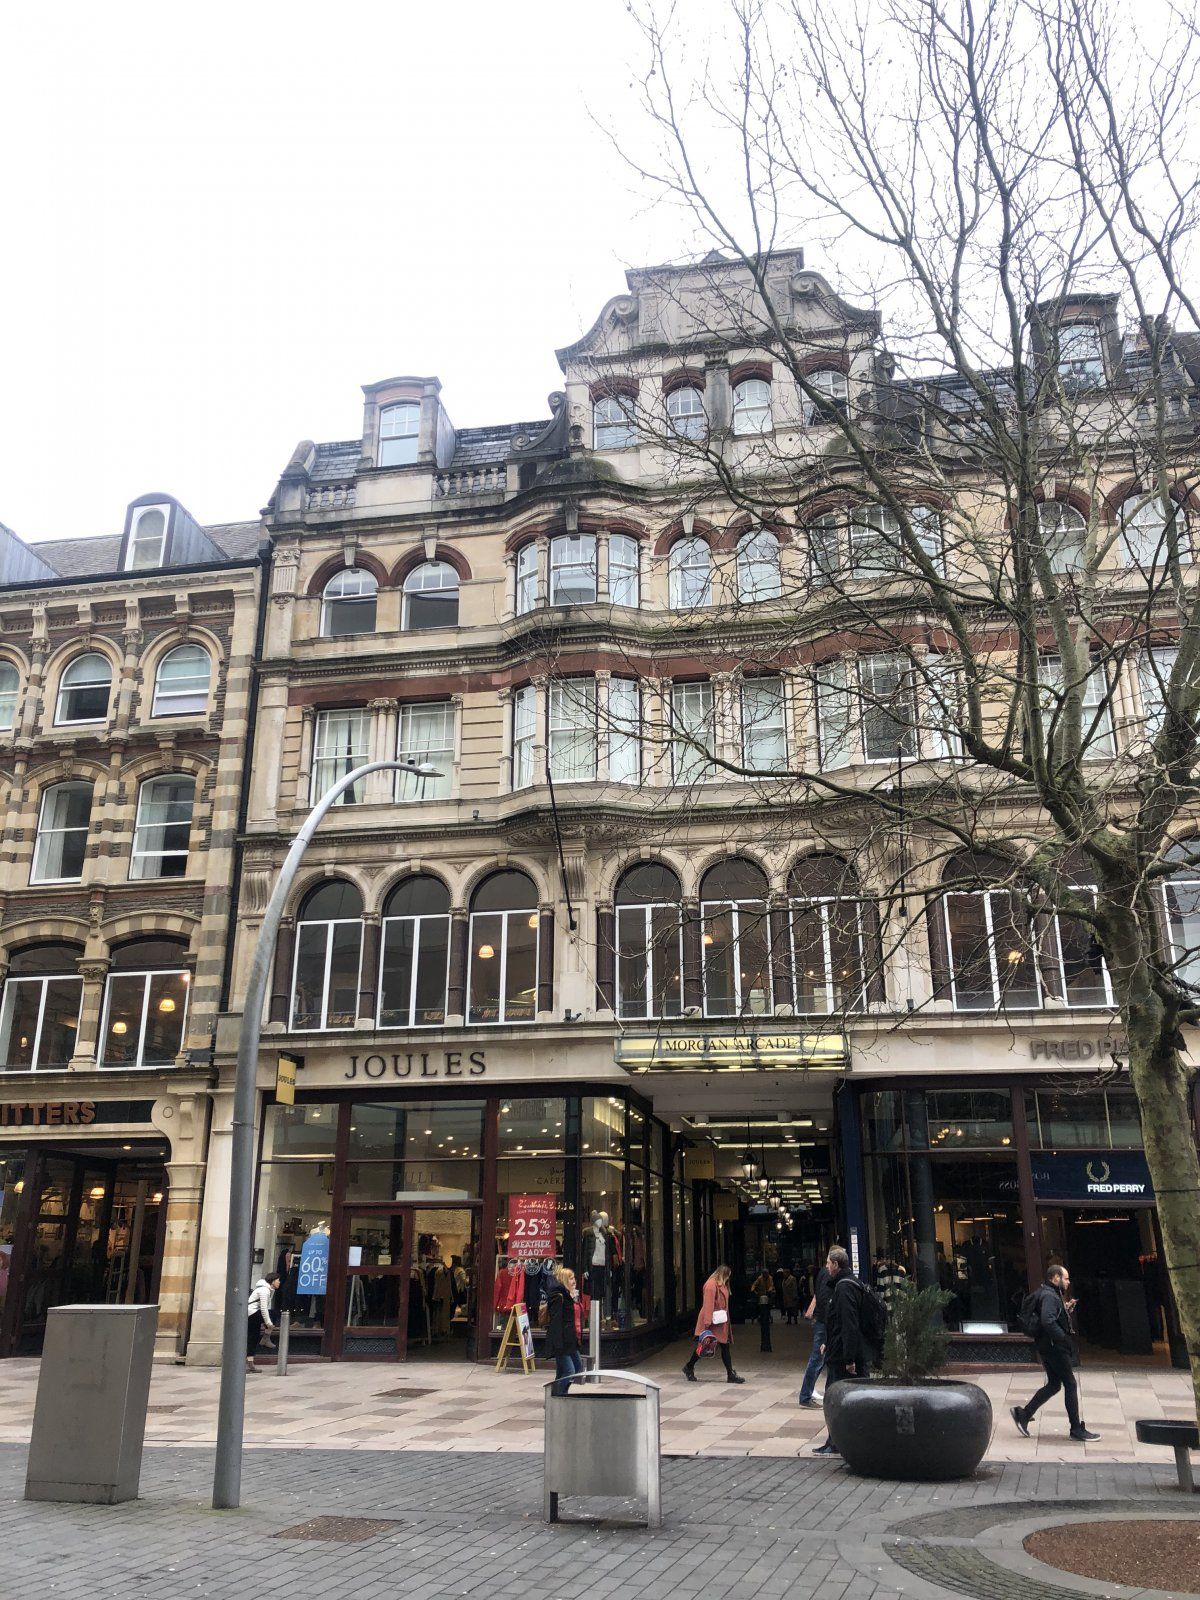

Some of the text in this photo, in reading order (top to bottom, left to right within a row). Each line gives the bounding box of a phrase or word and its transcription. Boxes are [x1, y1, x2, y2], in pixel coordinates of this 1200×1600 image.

[665, 1036, 796, 1052] MORGAN ARCADE
[1029, 1039, 1096, 1061] FRED
[344, 1051, 486, 1079] JOULES
[1087, 1184, 1146, 1193] FRED PERRY
[299, 1273, 328, 1287] OFF
